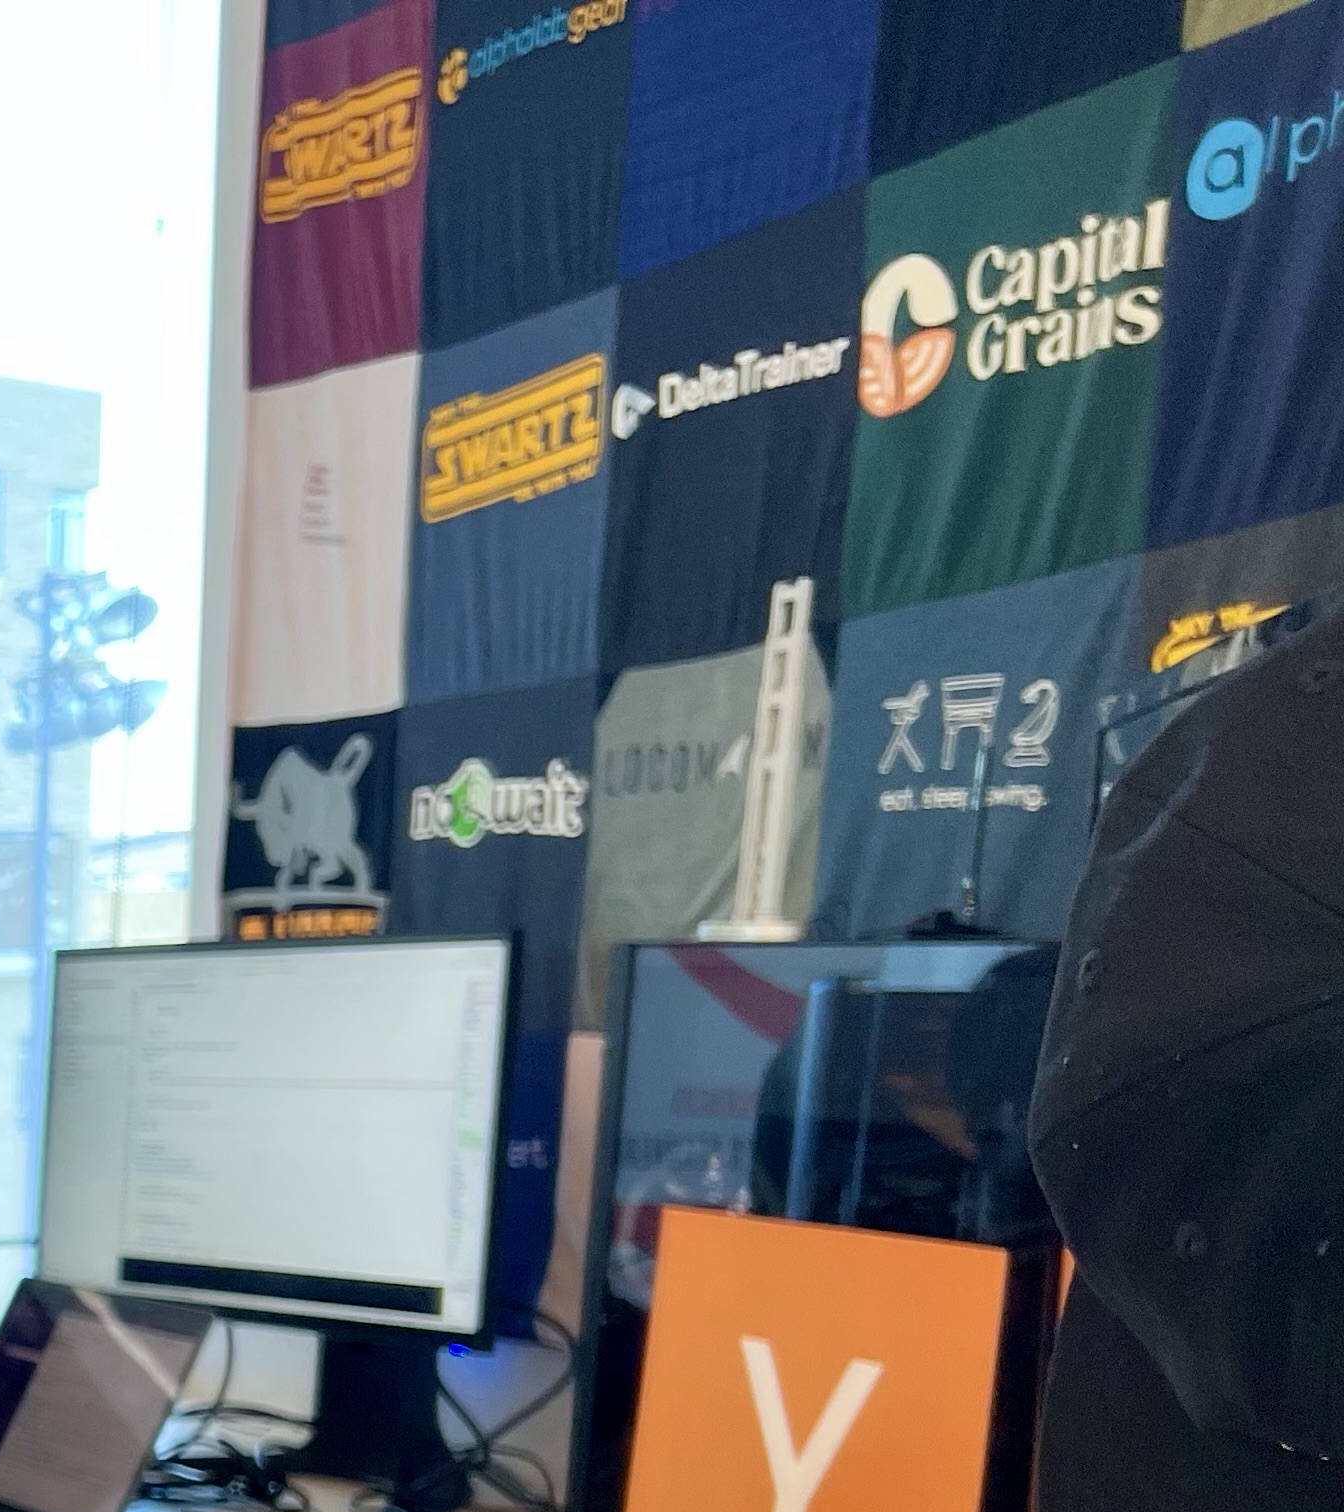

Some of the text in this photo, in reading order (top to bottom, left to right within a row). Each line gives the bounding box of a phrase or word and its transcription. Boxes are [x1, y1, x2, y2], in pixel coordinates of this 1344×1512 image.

[965, 198, 1172, 315] Capital
[966, 283, 1163, 381] Grains
[426, 392, 598, 490] SWARTZ
